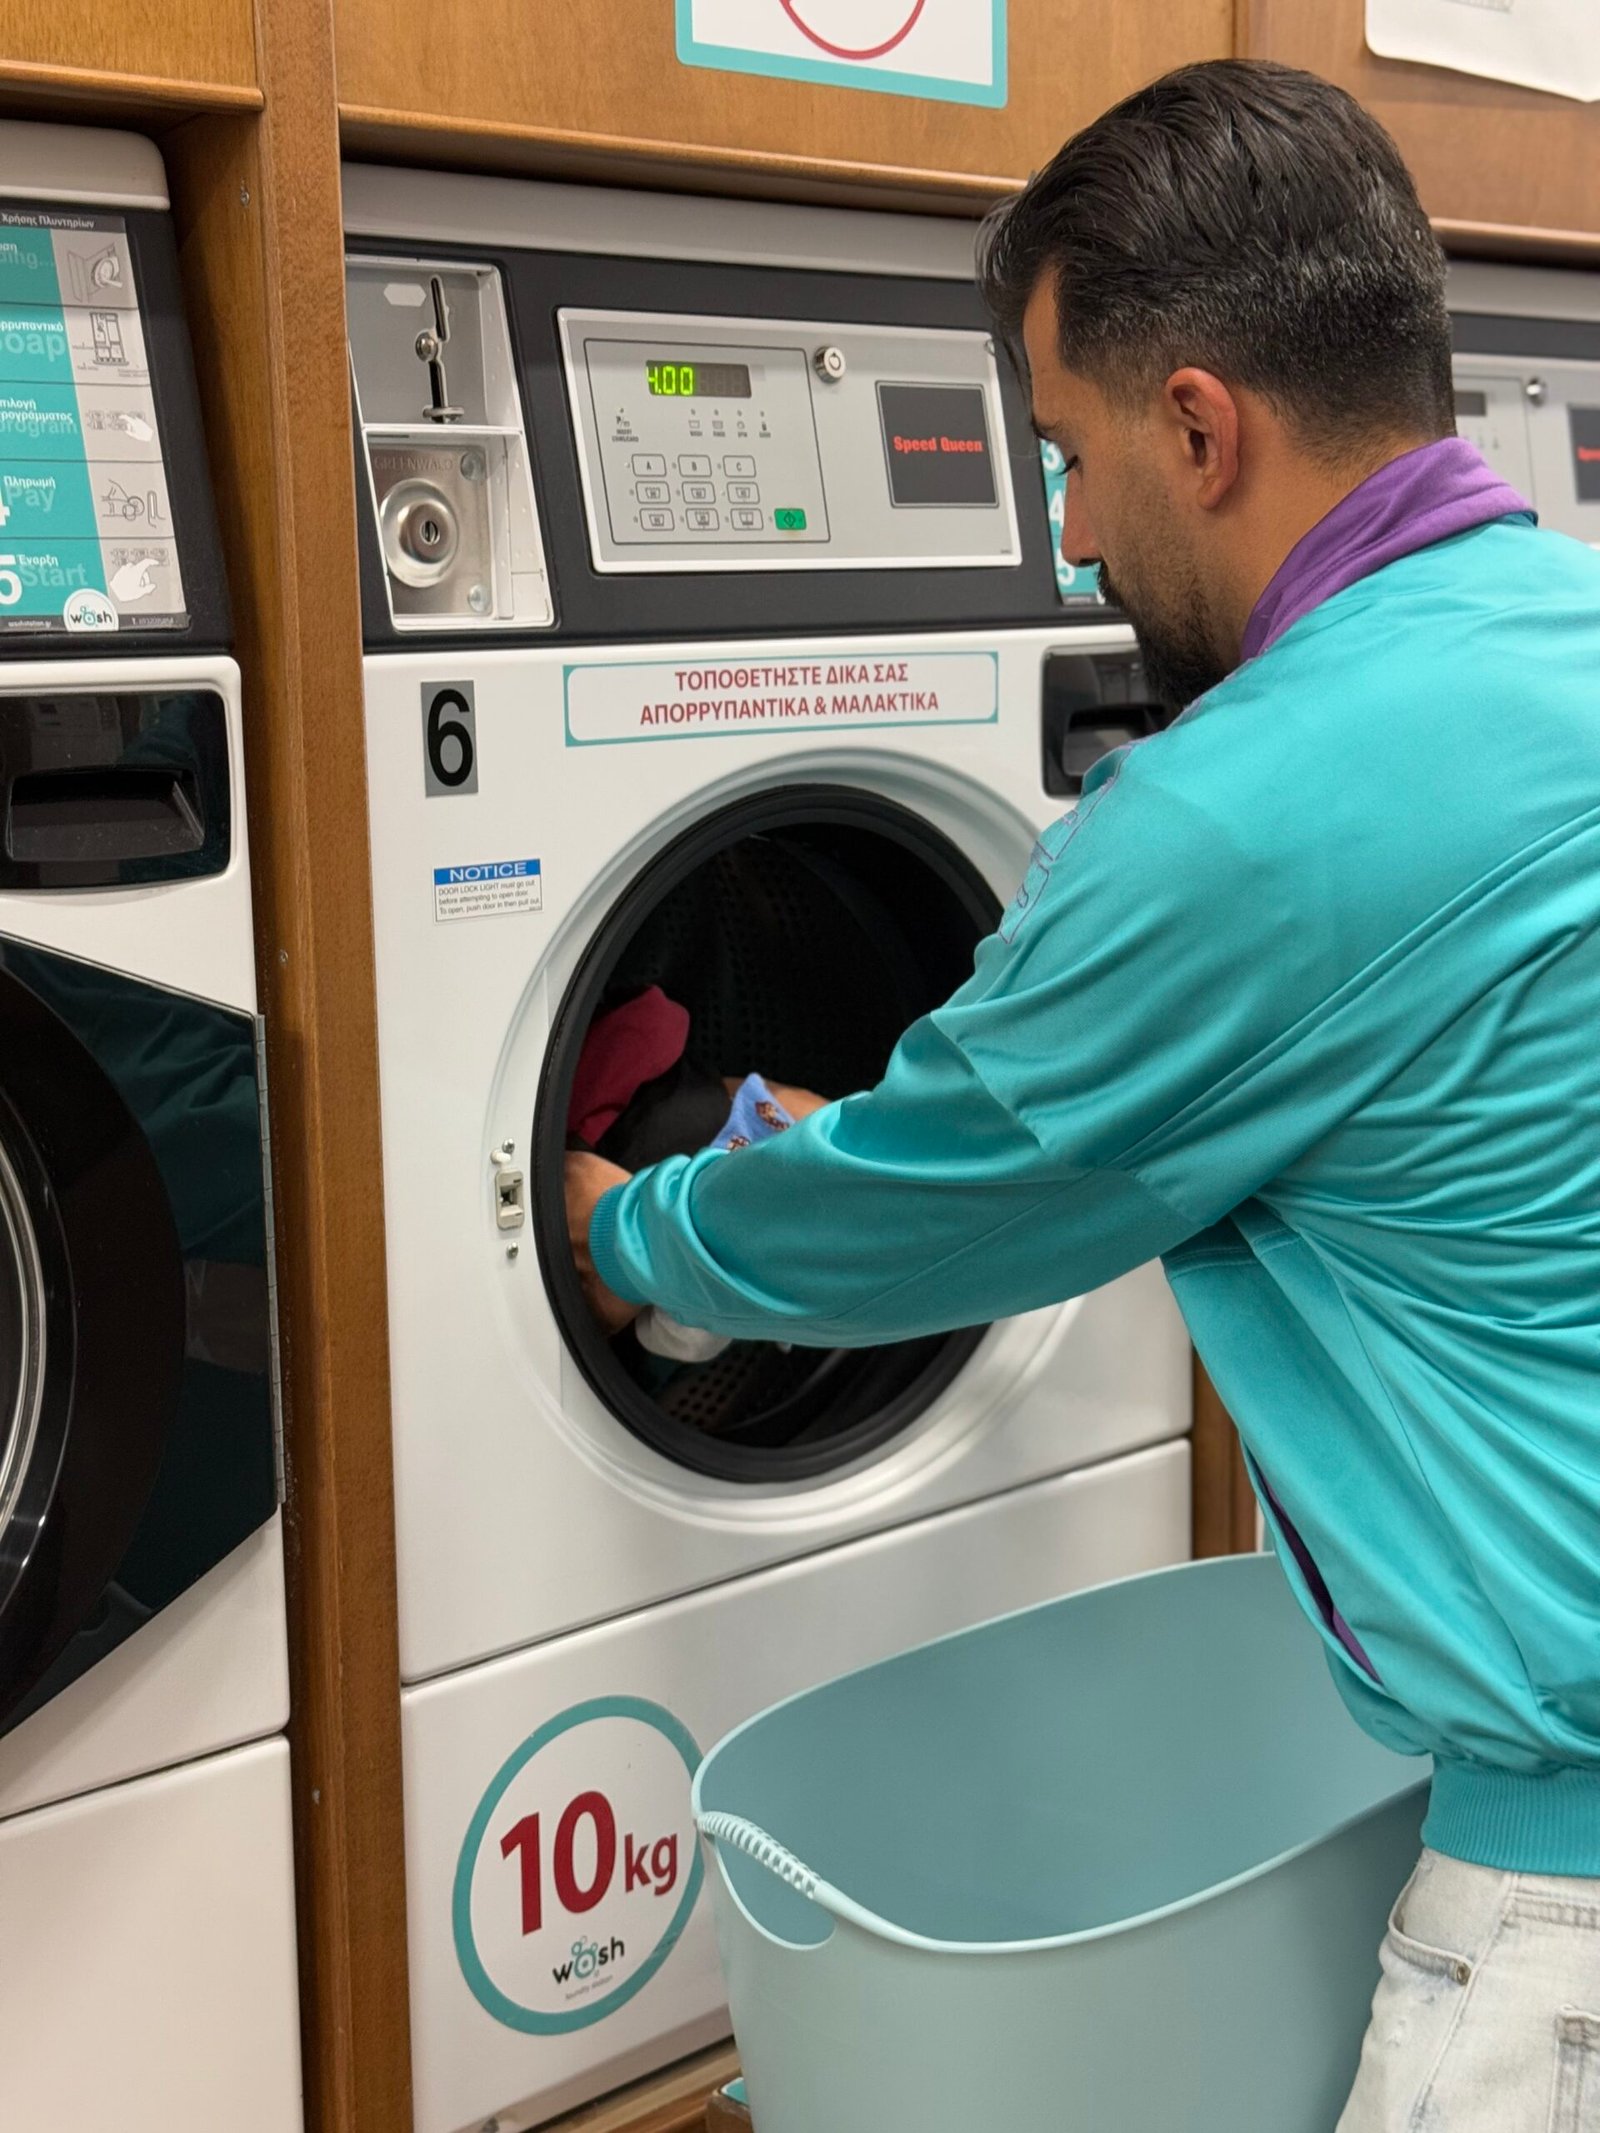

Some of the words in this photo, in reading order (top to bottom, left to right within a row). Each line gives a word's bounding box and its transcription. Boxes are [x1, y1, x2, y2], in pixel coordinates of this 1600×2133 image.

[0, 321, 64, 332] ρρυπαντικό
[0, 332, 66, 362] oap
[646, 365, 694, 395] 4.00
[0, 411, 74, 424] ρογράμματος
[894, 436, 937, 454] Speed
[940, 436, 983, 452] Queen
[646, 461, 652, 470] A
[5, 487, 55, 512] Pay
[19, 562, 88, 587] Start
[675, 666, 822, 692] ΤΟΠΟΘΕΤΗΣΤΕ
[826, 664, 870, 685] ΔΙΚΑ
[873, 662, 909, 683] ΣΑΣ
[640, 697, 810, 725] ΑΠΟΡΡΥΠΑΝΤΙΚΑ
[814, 696, 827, 715] &
[832, 692, 939, 715] ΜΑΛΑΚΤΙΚΑ
[427, 688, 473, 787] 6
[449, 861, 527, 882] NOTICE
[439, 887, 459, 896] DOOR
[460, 885, 478, 894] LOCK
[480, 883, 499, 892] LIGHT
[500, 882, 515, 890] must
[440, 897, 458, 905] before
[466, 903, 481, 912] push
[518, 898, 529, 906] pull
